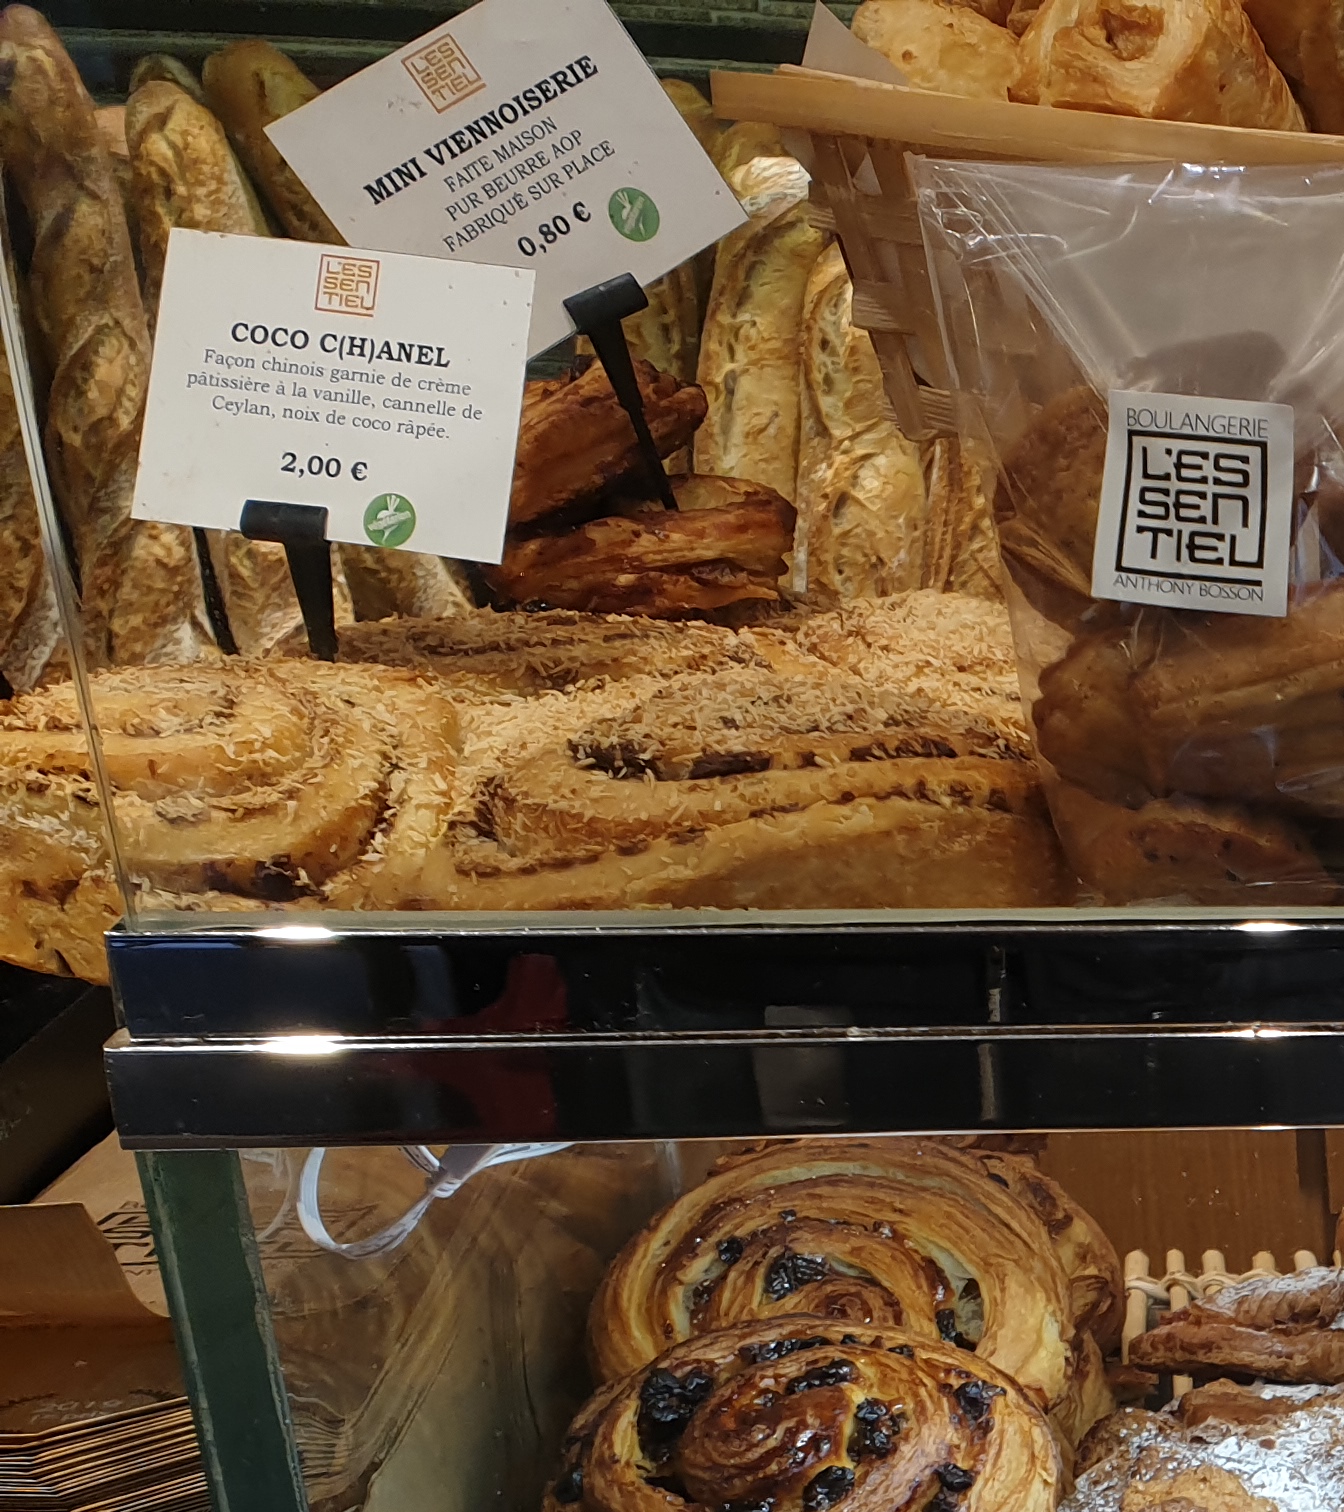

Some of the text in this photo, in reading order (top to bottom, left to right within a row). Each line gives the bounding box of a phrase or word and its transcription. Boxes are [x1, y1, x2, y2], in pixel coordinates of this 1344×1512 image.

[362, 55, 599, 205] MINI VIENNOISERIE
[442, 116, 558, 193] FAITE MAISON
[442, 140, 616, 253] FABRIQUÉ SUR PLACE
[444, 129, 582, 221] PUR BEURRE AOP
[517, 201, 592, 257] 0,80 €
[231, 322, 451, 369] COCO C(H)ANEL
[204, 351, 472, 397] Façon chinois garnie de crème
[1126, 407, 1269, 438] BOULANGERIE
[280, 452, 368, 482] 2,00 €
[1113, 573, 1265, 602] ANTHONY BOSSON
